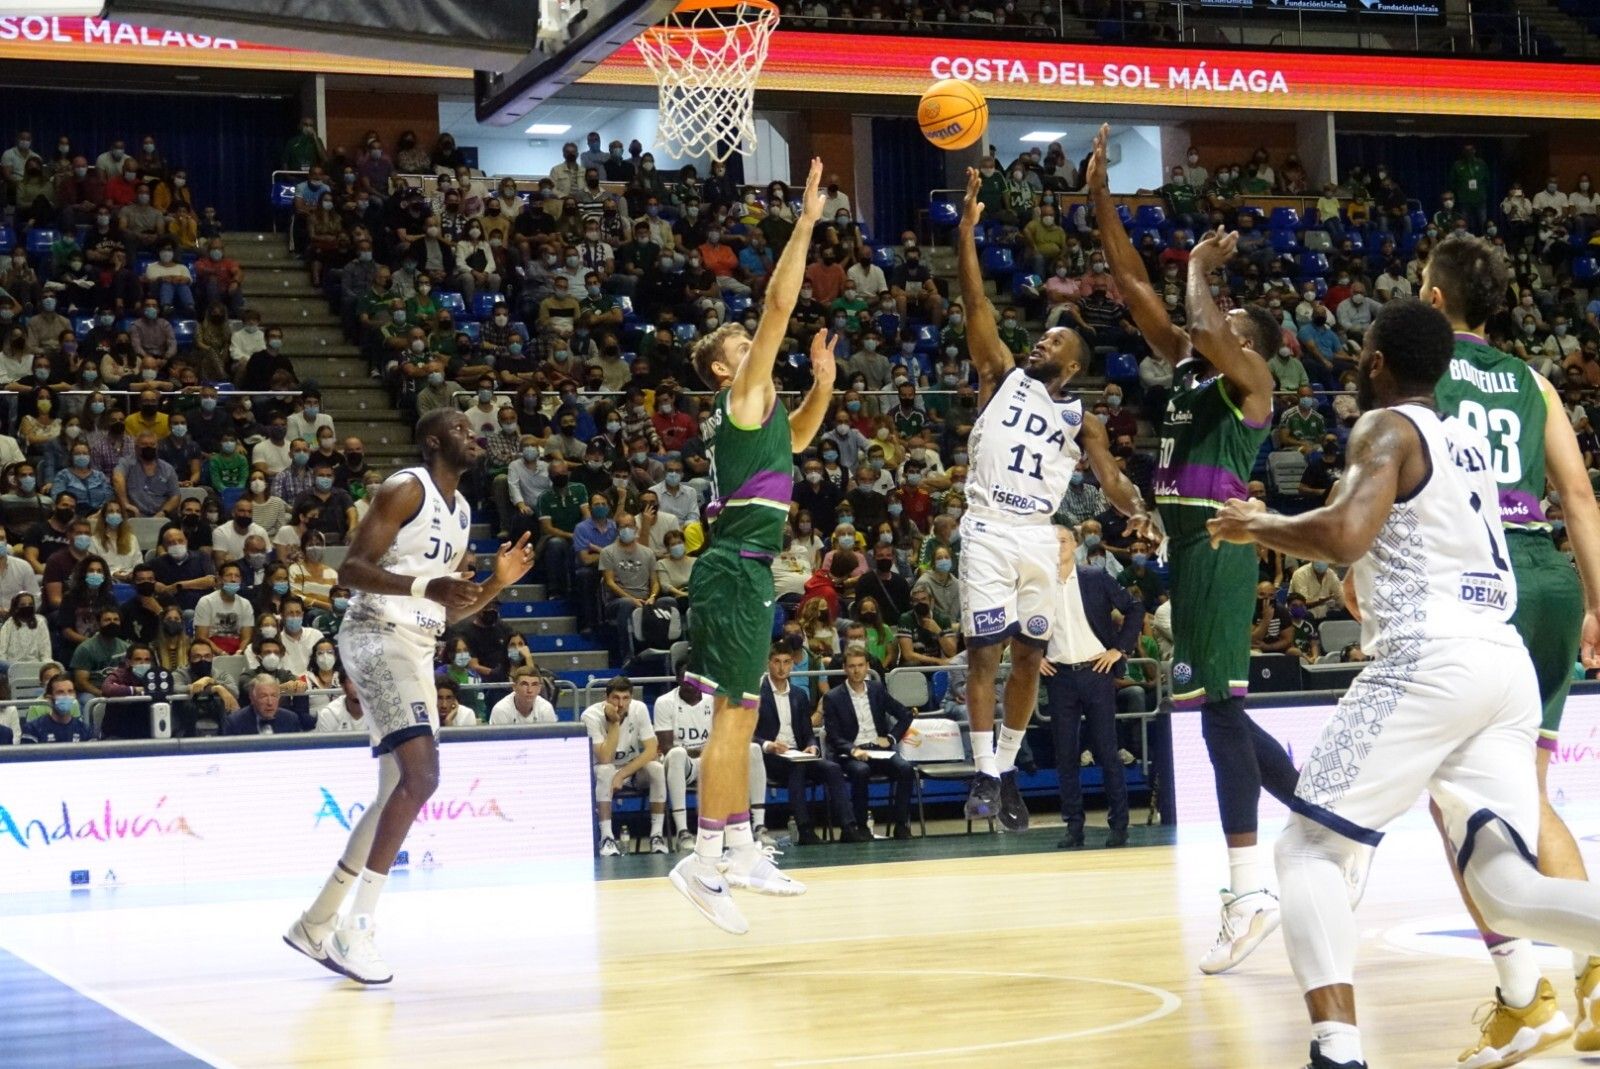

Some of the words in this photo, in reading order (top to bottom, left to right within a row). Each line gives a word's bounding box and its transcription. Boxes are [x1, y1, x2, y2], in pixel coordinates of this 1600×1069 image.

[0, 16, 72, 43] SOL
[930, 56, 1029, 83] COSTA
[1038, 61, 1094, 86] DEL
[1102, 64, 1160, 88] SOL
[1168, 61, 1289, 93] MÁLAGA
[1001, 405, 1066, 452] JDA
[1007, 443, 1044, 480] 11
[423, 536, 458, 564] JD
[975, 611, 1007, 629] Plus
[677, 727, 709, 740] JDA
